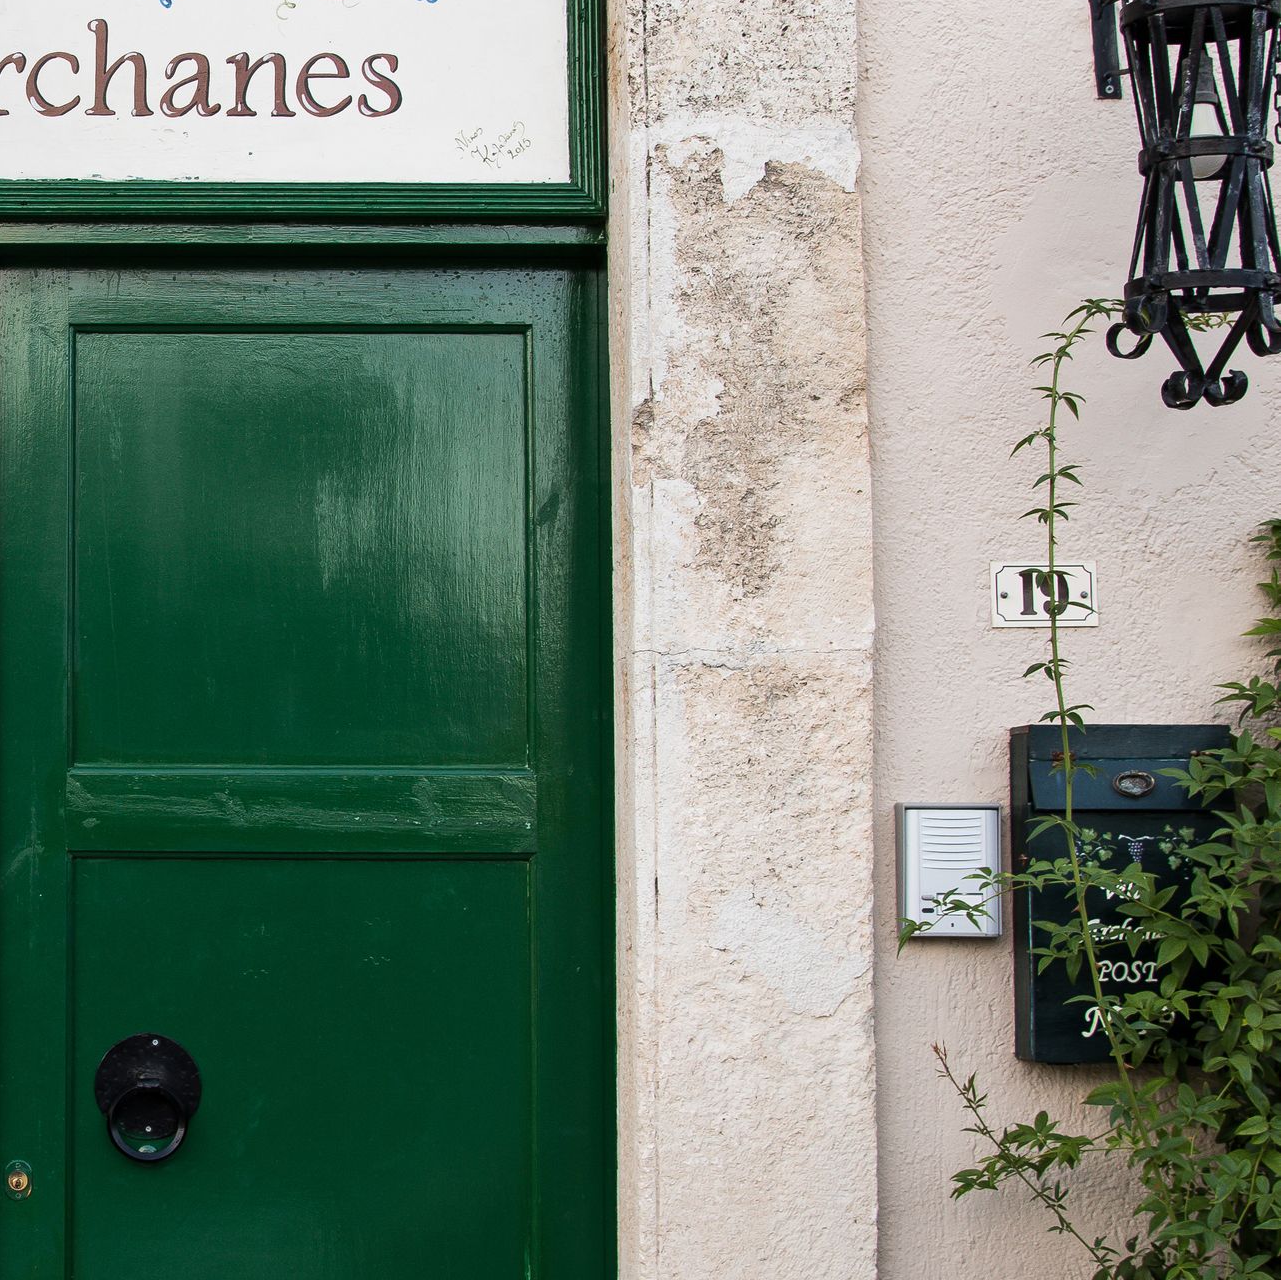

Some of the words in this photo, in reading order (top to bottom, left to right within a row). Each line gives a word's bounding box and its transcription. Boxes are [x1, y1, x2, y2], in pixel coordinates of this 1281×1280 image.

[507, 137, 532, 160] 2015
[1018, 569, 1070, 617] 19
[1096, 959, 1159, 984] POST
